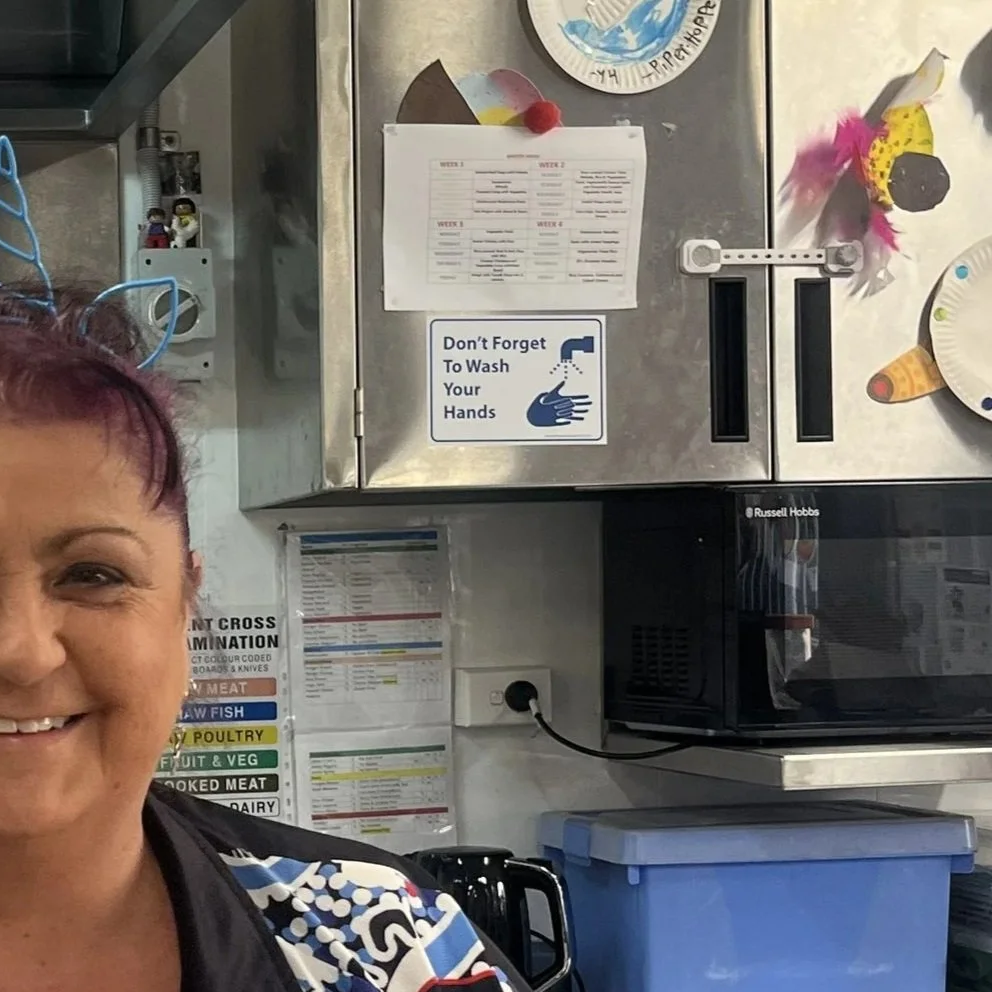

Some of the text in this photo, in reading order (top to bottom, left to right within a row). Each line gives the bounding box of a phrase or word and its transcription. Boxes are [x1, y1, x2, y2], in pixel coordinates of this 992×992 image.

[443, 336, 546, 353] Don't Forget
[443, 358, 510, 373] To Wash
[443, 382, 481, 396] Your
[444, 405, 496, 419] Hands
[754, 506, 820, 518] Russell Hobbs
[218, 616, 276, 630] CROSS
[204, 655, 240, 664] COLOUR
[242, 653, 272, 662] CODED
[238, 664, 269, 672] KNIVES
[207, 681, 248, 695] MEAT
[180, 706, 244, 720] AW FISH
[193, 729, 264, 743] POULTRY
[212, 754, 222, 768] &
[227, 753, 258, 766] VEG
[164, 777, 267, 792] OOKED MEAT
[230, 801, 276, 813] DAIRY
